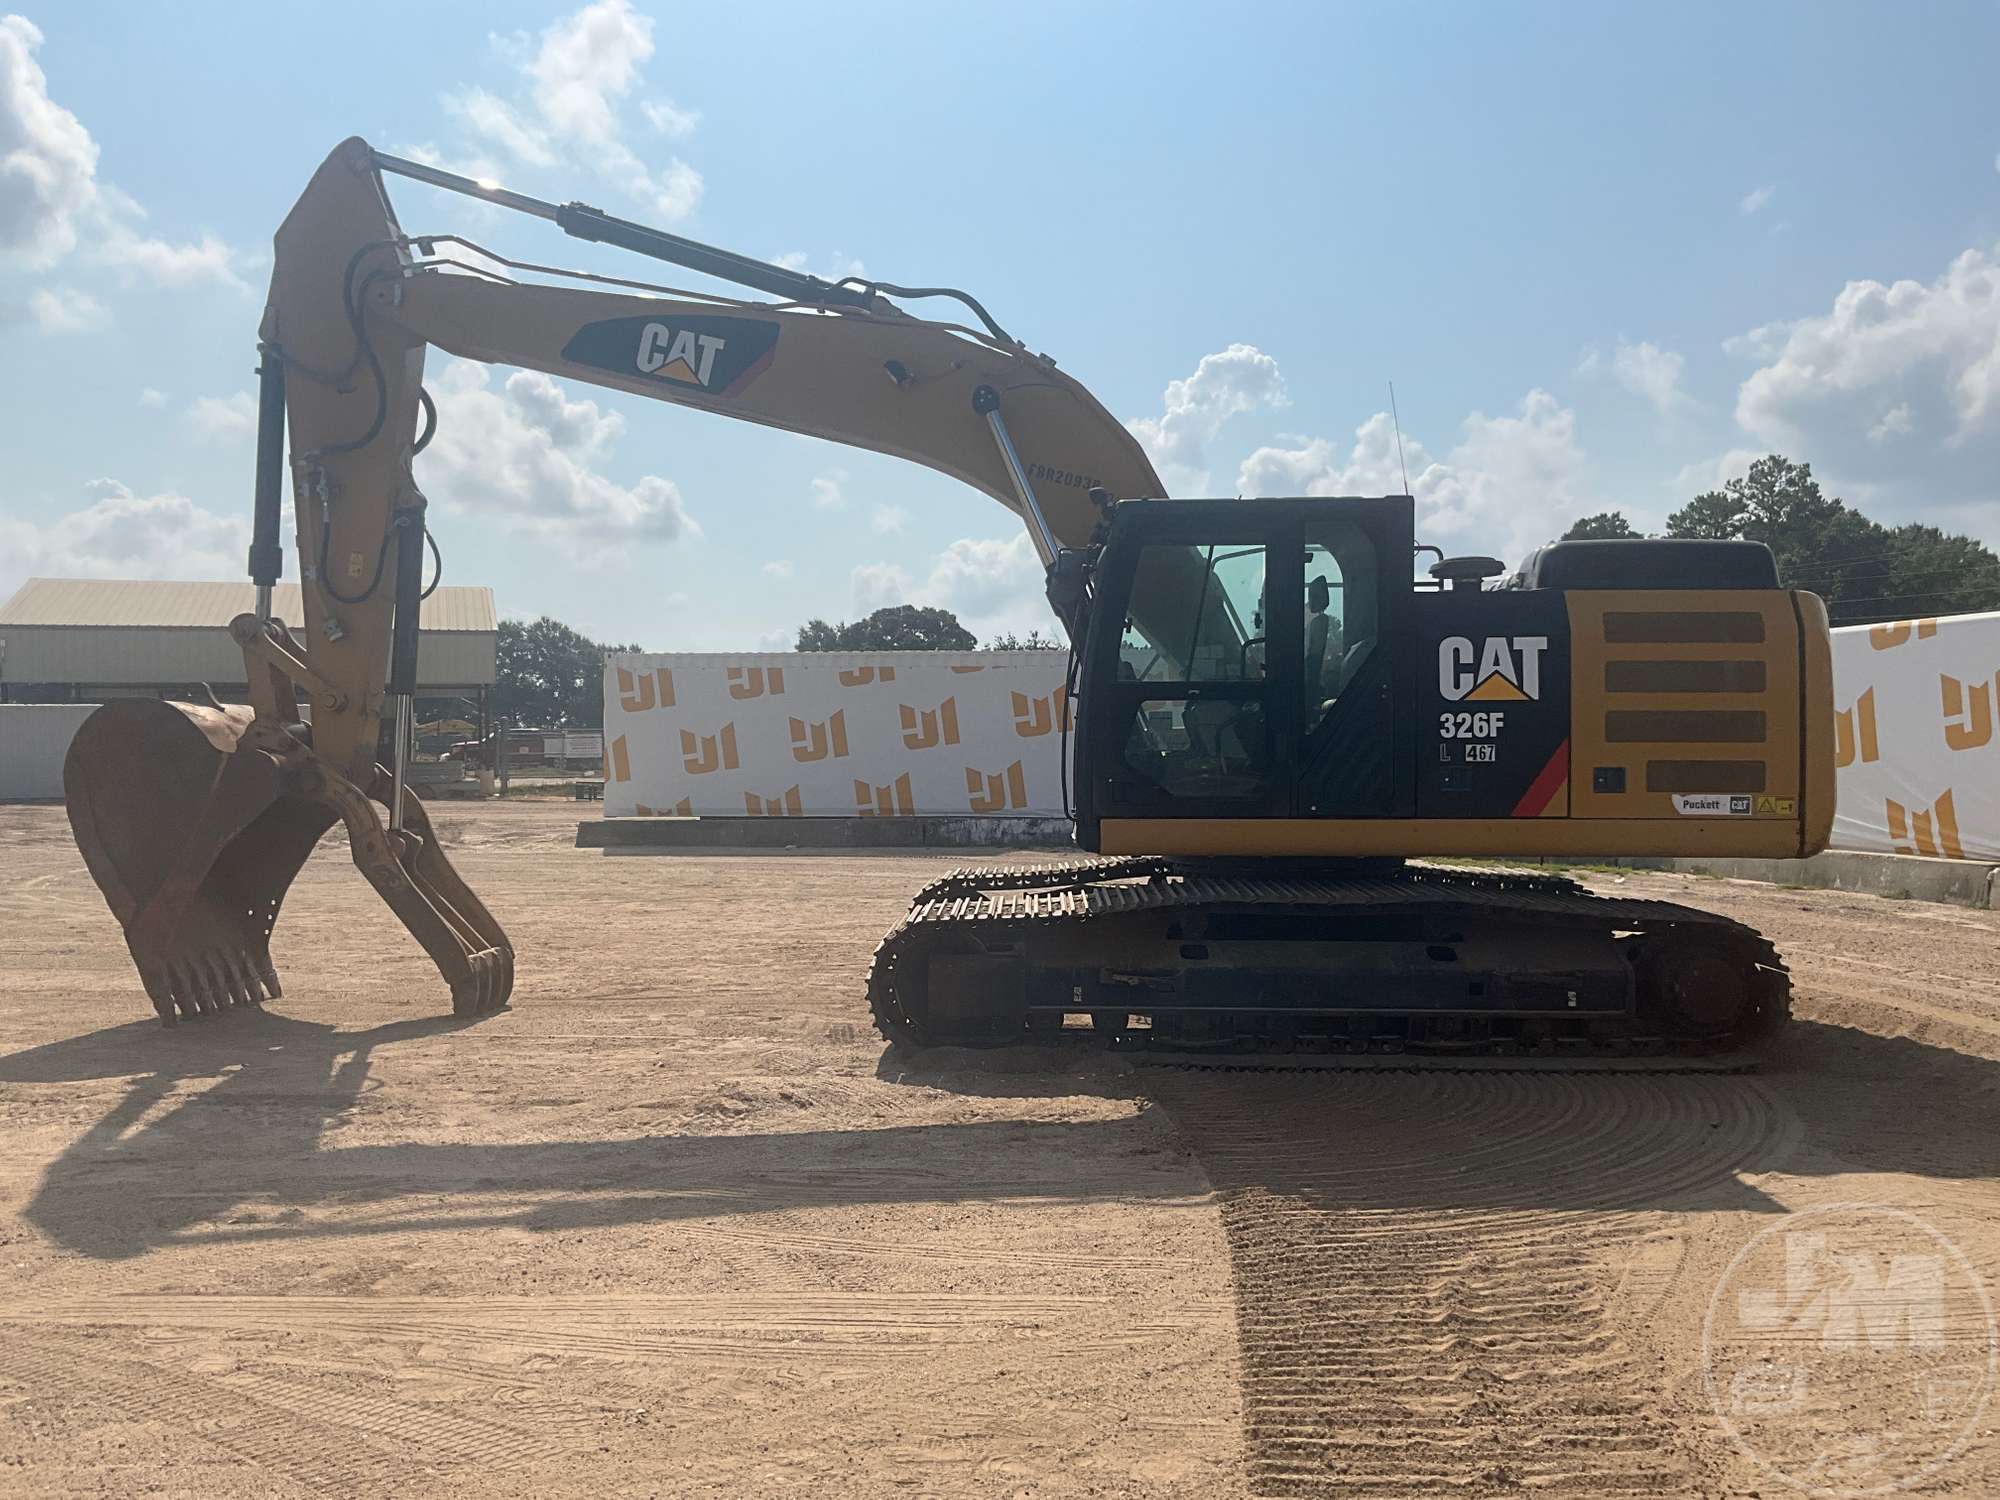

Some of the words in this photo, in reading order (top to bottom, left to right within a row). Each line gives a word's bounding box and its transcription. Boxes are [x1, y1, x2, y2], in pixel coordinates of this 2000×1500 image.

[636, 322, 726, 387] CAT
[1438, 636, 1548, 701] CAT
[1440, 712, 1504, 738] 326F
[1466, 745, 1495, 761] 467
[1683, 800, 1720, 810] Puckett
